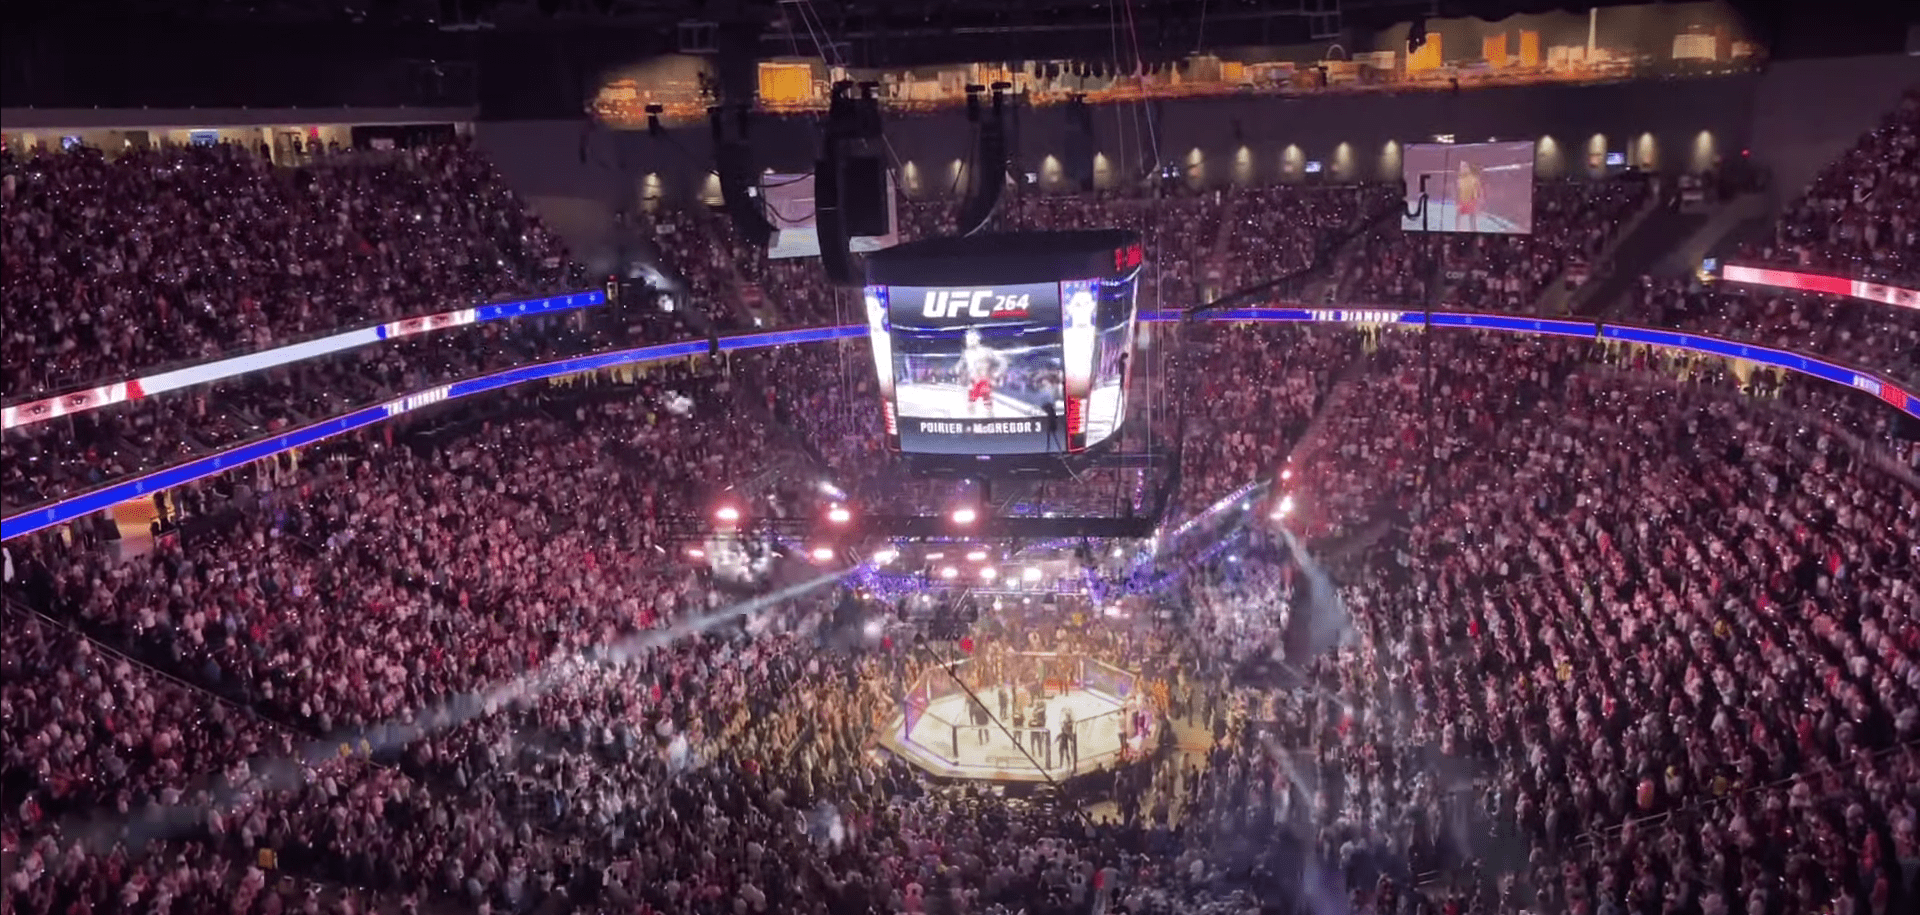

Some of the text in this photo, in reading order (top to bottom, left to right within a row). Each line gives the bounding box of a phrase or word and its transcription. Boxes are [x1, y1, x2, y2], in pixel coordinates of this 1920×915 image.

[923, 290, 1030, 318] UFC 264
[920, 422, 963, 434] POIRIER
[1035, 421, 1042, 433] 3
